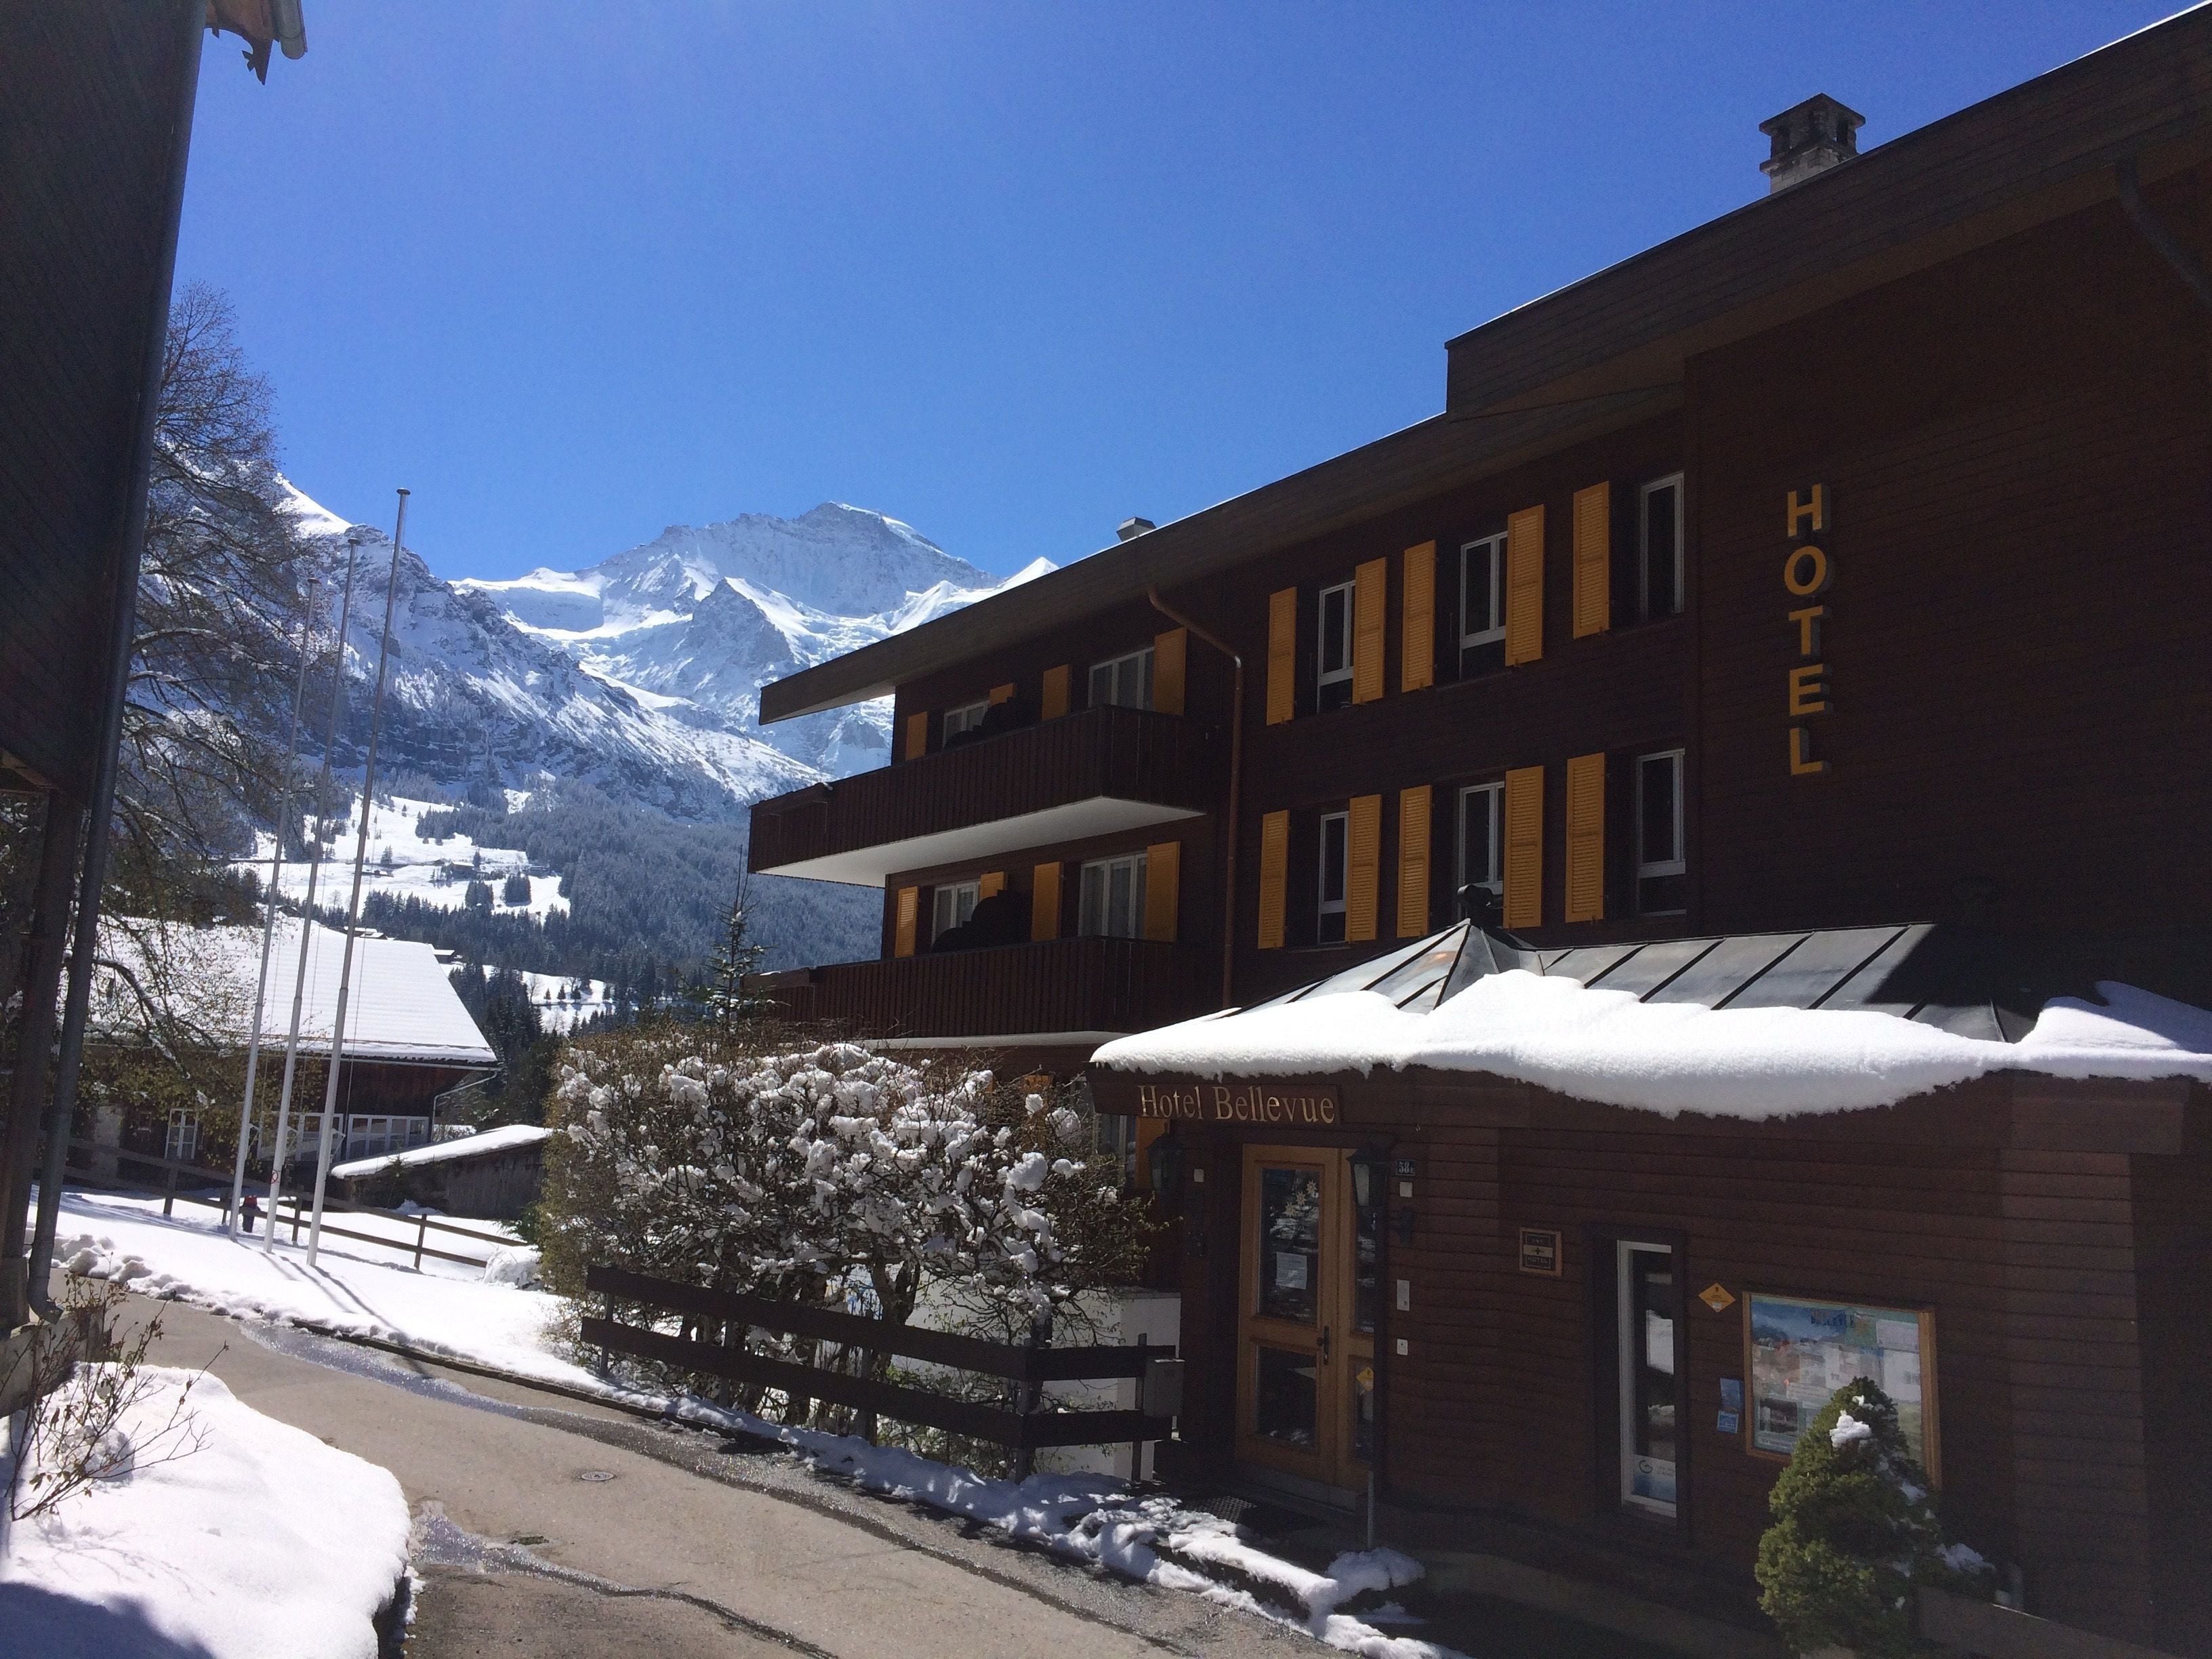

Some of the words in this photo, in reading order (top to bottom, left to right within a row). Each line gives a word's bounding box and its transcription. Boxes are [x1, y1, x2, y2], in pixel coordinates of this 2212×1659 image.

[1784, 483, 1828, 776] HOTEL
[1137, 1085, 1204, 1120] Hotel
[1212, 1085, 1336, 1124] Bellevue
